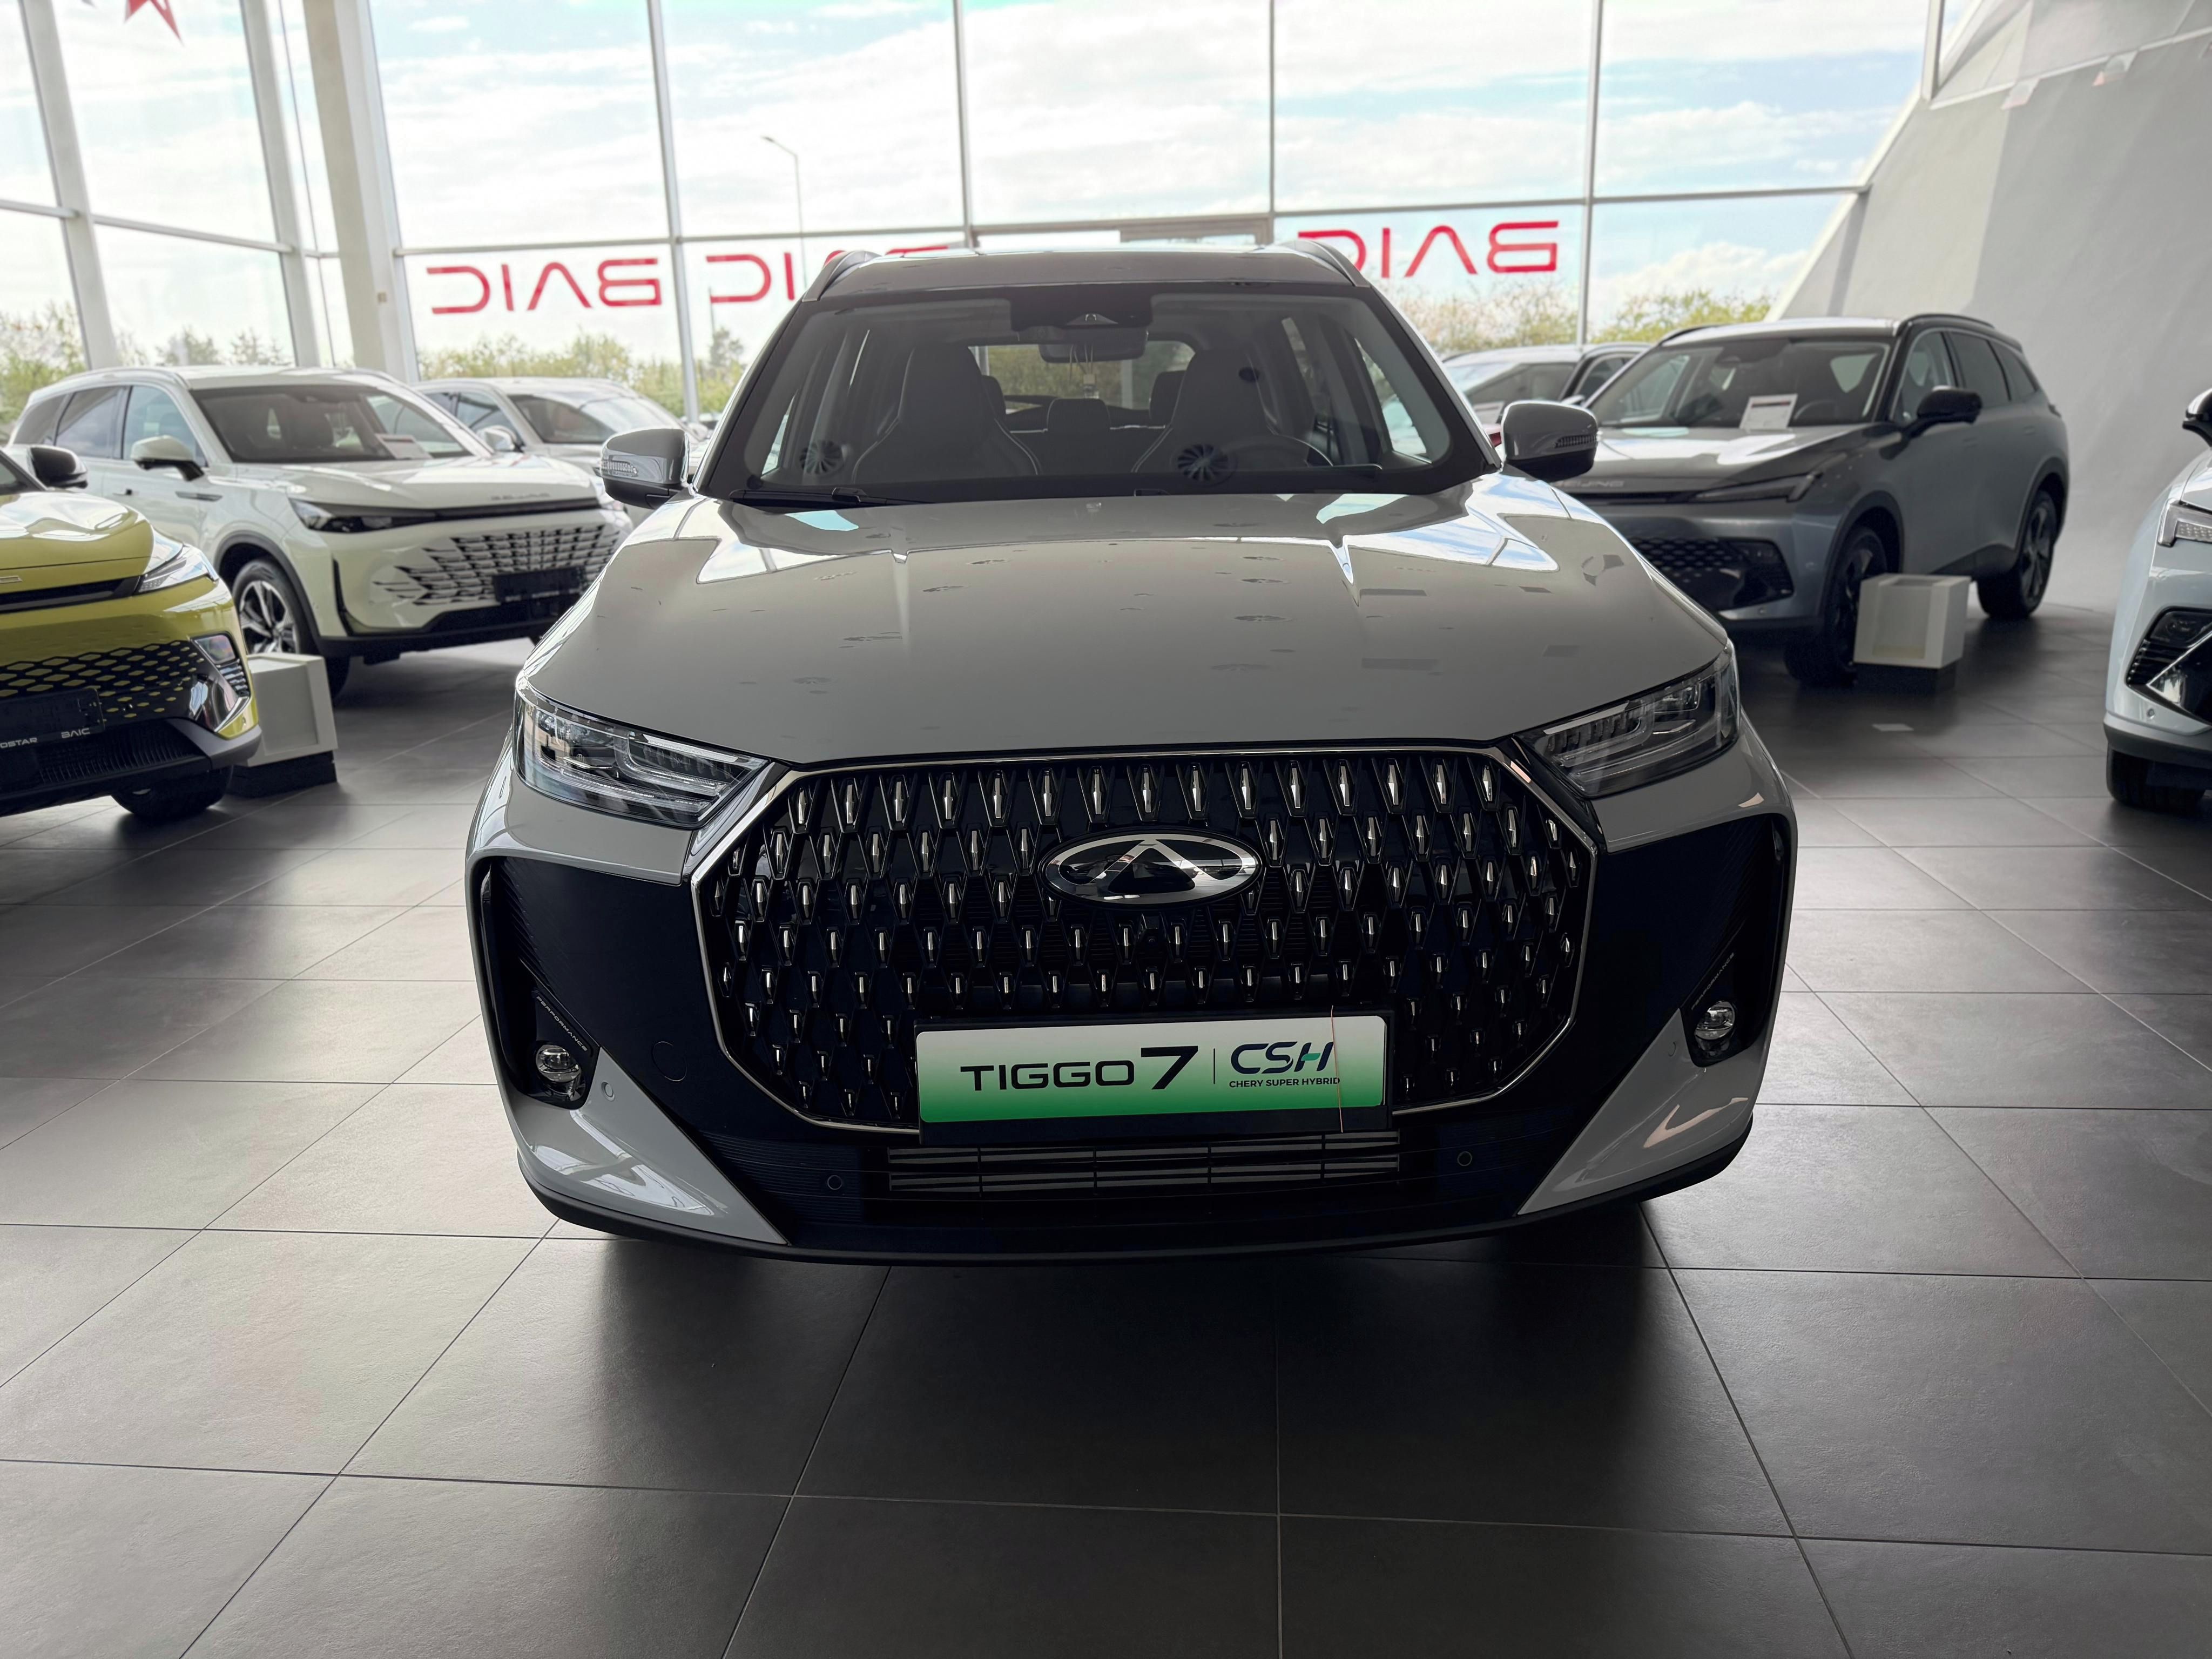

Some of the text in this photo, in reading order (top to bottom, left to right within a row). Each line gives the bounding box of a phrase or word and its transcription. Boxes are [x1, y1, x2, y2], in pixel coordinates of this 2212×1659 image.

[60, 727, 90, 739] BAIC
[1691, 952, 1734, 1010] PERFORMANCE
[536, 996, 588, 1051] PERFORMANCE
[960, 1041, 1334, 1091] TIGGO 7 CSH
[1229, 1077, 1340, 1088] CHERY SUPER HYBRID
